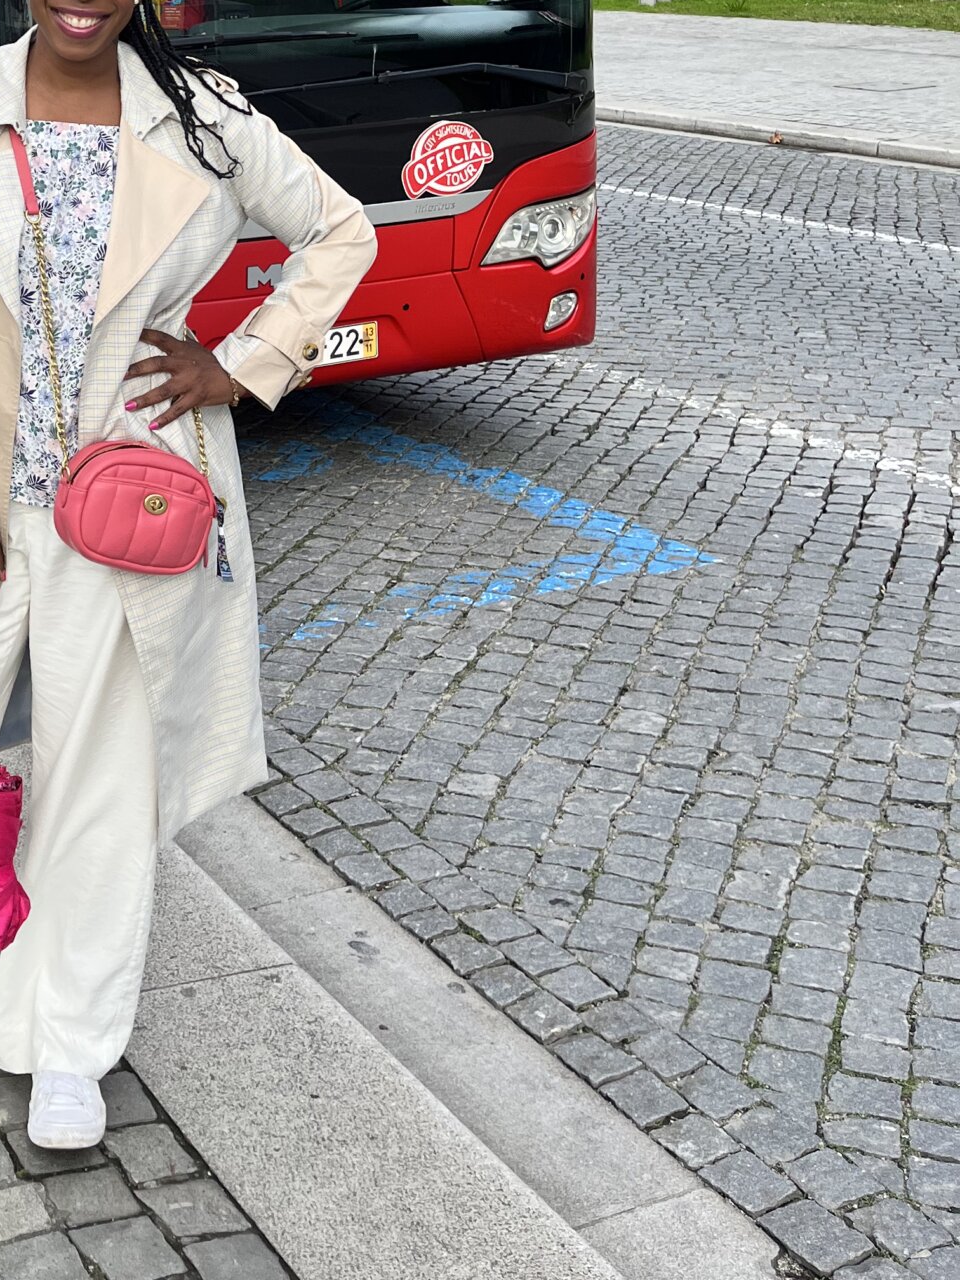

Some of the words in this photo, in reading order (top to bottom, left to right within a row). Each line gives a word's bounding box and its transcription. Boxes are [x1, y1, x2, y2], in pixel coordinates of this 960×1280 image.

[424, 135, 437, 151] CITY
[435, 124, 475, 140] SIGHTSEEING
[413, 141, 491, 185] OFFICIAL
[445, 163, 478, 186] TOUR
